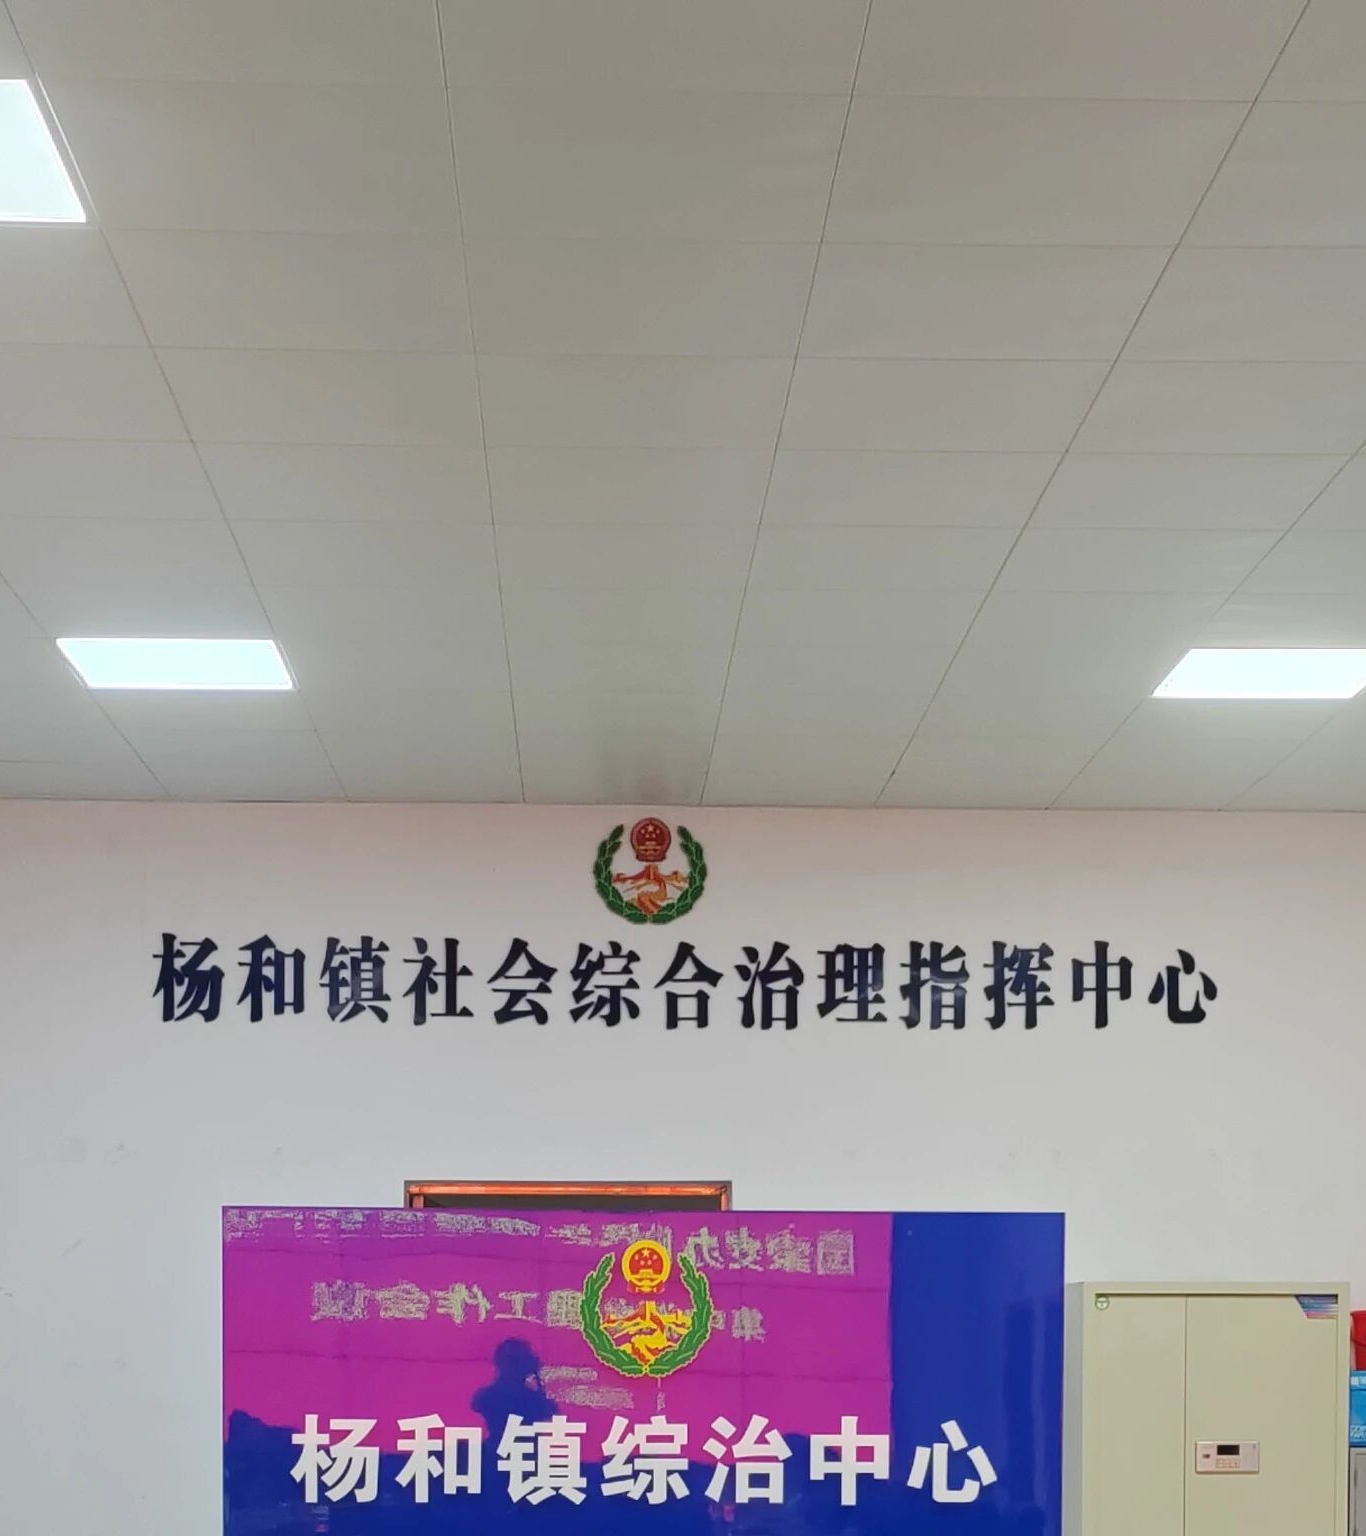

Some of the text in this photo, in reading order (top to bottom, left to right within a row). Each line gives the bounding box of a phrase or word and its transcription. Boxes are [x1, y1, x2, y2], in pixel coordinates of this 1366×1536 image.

[152, 932, 1218, 1031] 杨和镇社会综合治理指挥中心
[290, 1413, 997, 1506] 杨和镇综治中心
